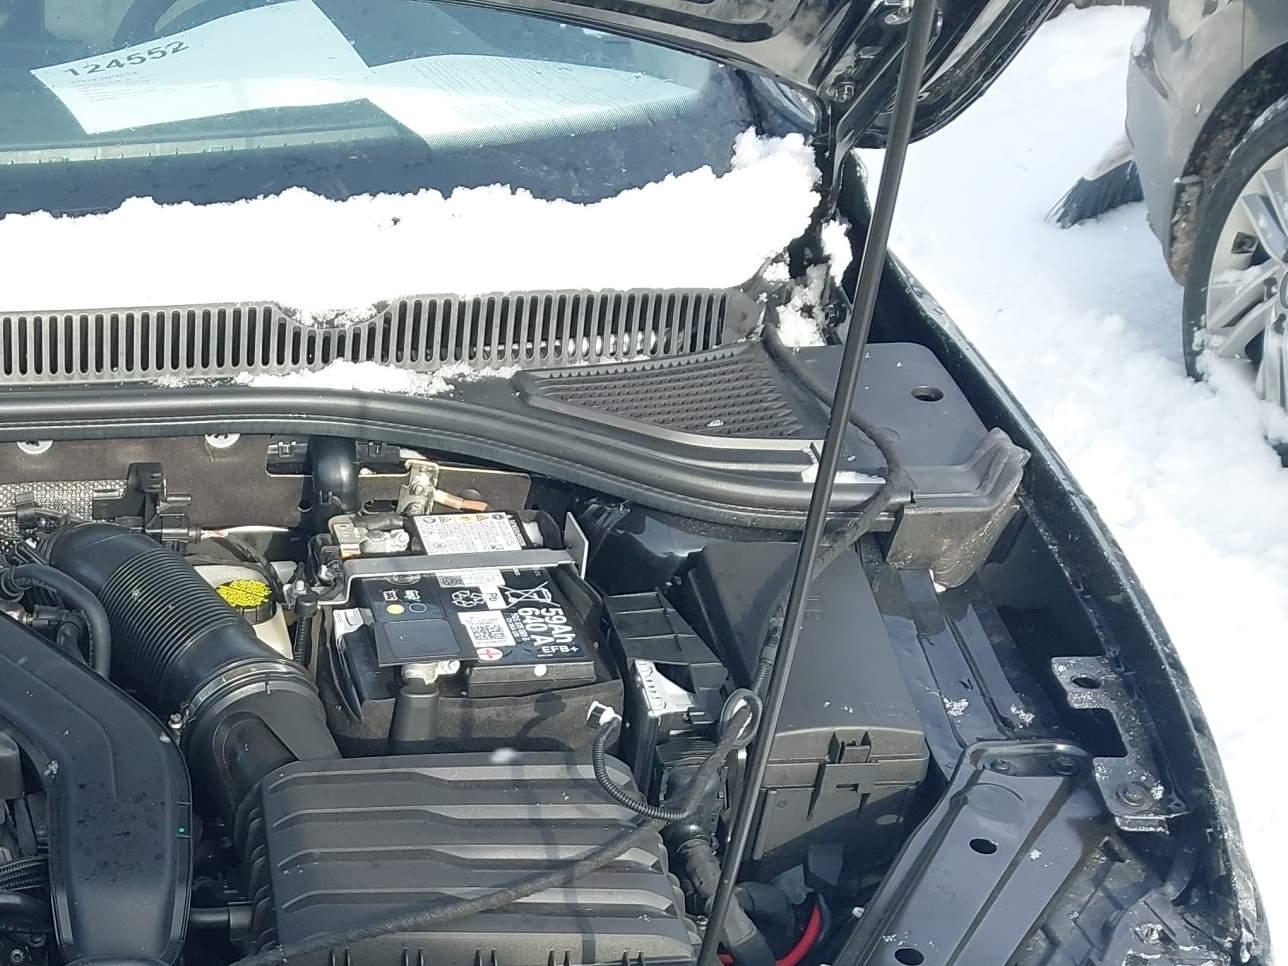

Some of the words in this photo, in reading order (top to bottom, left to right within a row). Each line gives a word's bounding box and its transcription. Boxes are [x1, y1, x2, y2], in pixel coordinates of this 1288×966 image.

[65, 40, 189, 76] 124552
[518, 607, 548, 632] 640
[541, 607, 576, 643] 59Ah
[531, 634, 555, 646] A
[541, 645, 580, 653] EFB+
